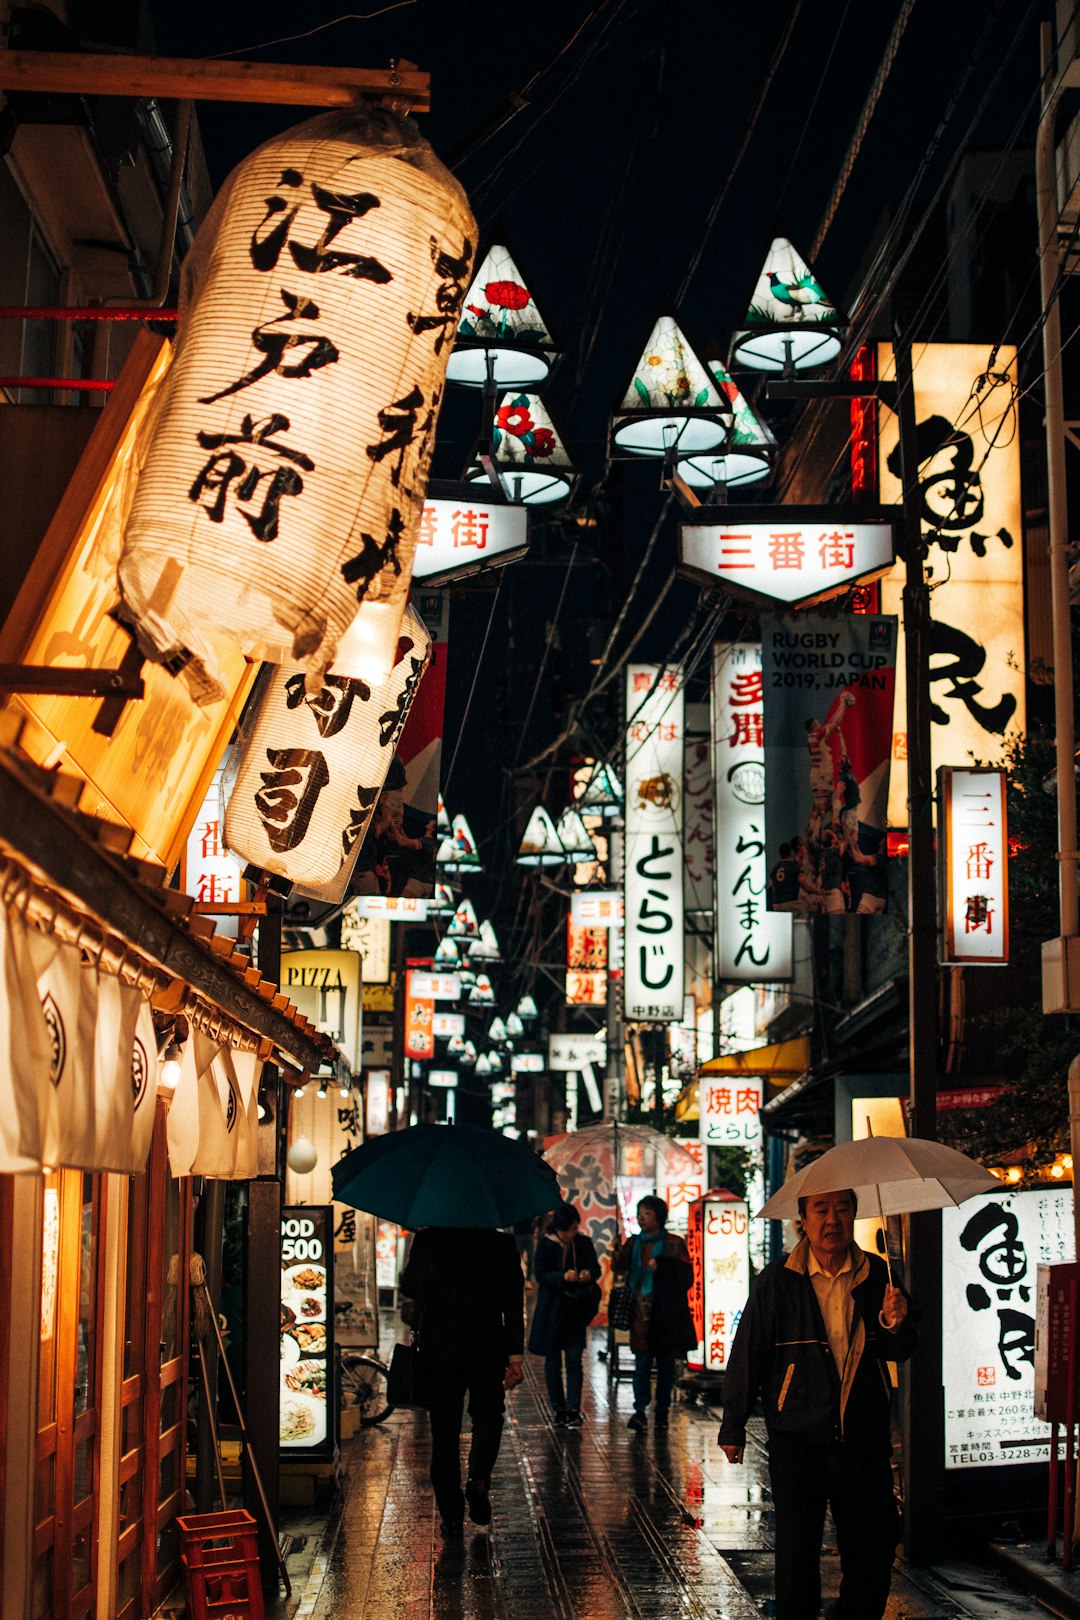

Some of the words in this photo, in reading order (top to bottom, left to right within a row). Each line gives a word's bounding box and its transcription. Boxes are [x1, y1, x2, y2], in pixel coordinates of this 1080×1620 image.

[187, 168, 393, 542] 江戸前
[718, 532, 855, 570] 三番街
[772, 633, 839, 649] RUGBY
[772, 652, 845, 669] WORLD
[847, 653, 887, 671] CUP
[772, 672, 822, 692] 2019,
[823, 673, 886, 690] JAPAN
[732, 824, 771, 968] らんまん
[636, 836, 674, 990] とらじ
[287, 967, 343, 992] PIZZA
[632, 1005, 676, 1018] 中野店
[706, 1087, 761, 1115] 焼肉
[707, 1122, 759, 1141] とらじ
[706, 1208, 747, 1236] とらじ
[281, 1239, 322, 1261] 500
[959, 1201, 1036, 1381] 魚民
[709, 1310, 726, 1364] 焼肉
